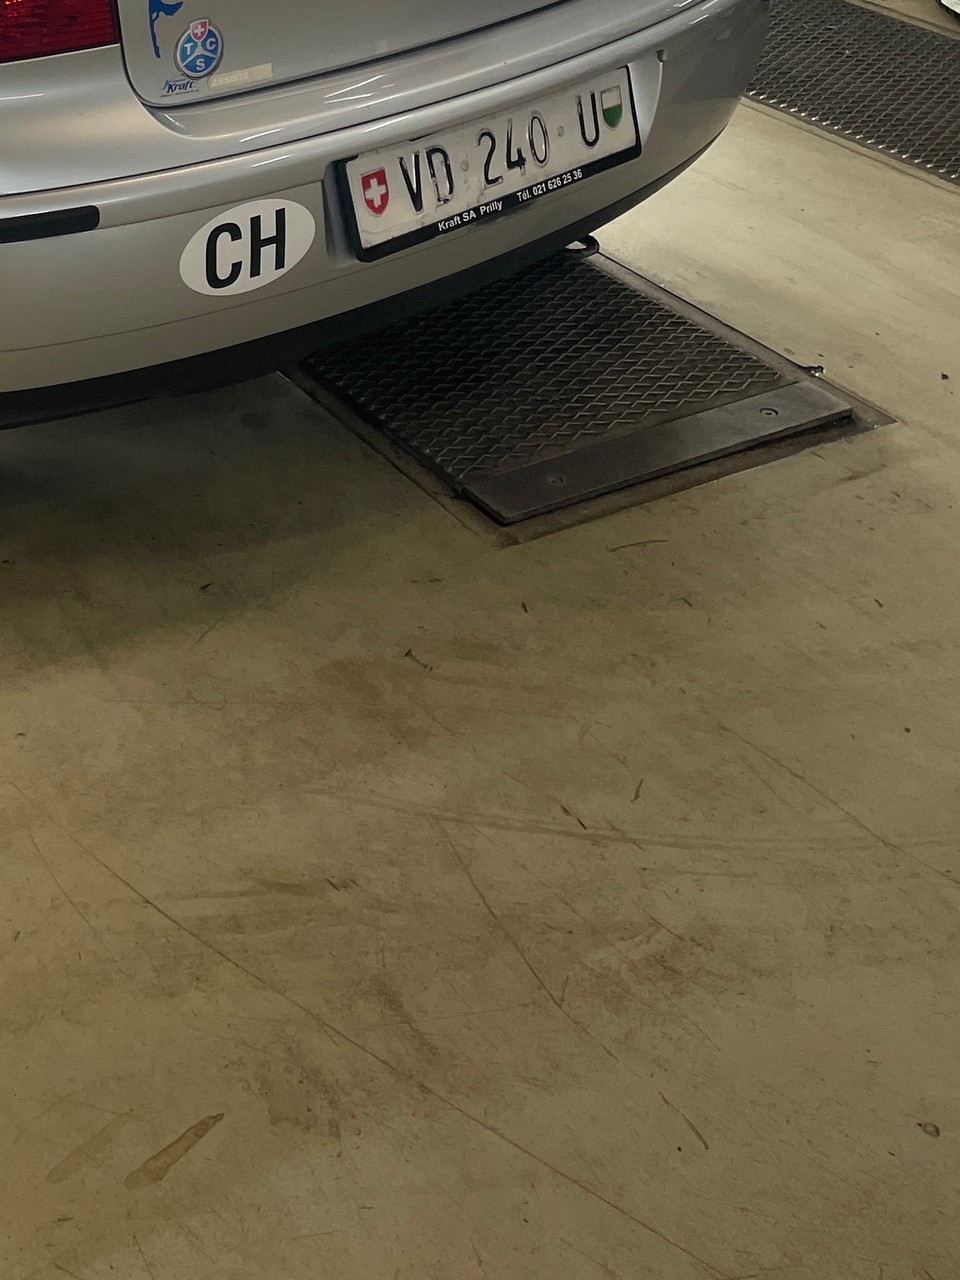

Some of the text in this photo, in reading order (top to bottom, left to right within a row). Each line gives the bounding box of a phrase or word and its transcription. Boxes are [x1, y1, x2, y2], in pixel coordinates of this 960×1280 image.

[397, 89, 601, 215] VD 240 U
[438, 214, 462, 233] Kraft
[462, 209, 477, 224] SA
[479, 199, 504, 220] Prilly
[532, 183, 547, 197] 021
[547, 178, 562, 192] 626
[562, 173, 573, 187] 25
[573, 168, 583, 184] 36
[205, 207, 286, 290] CH
